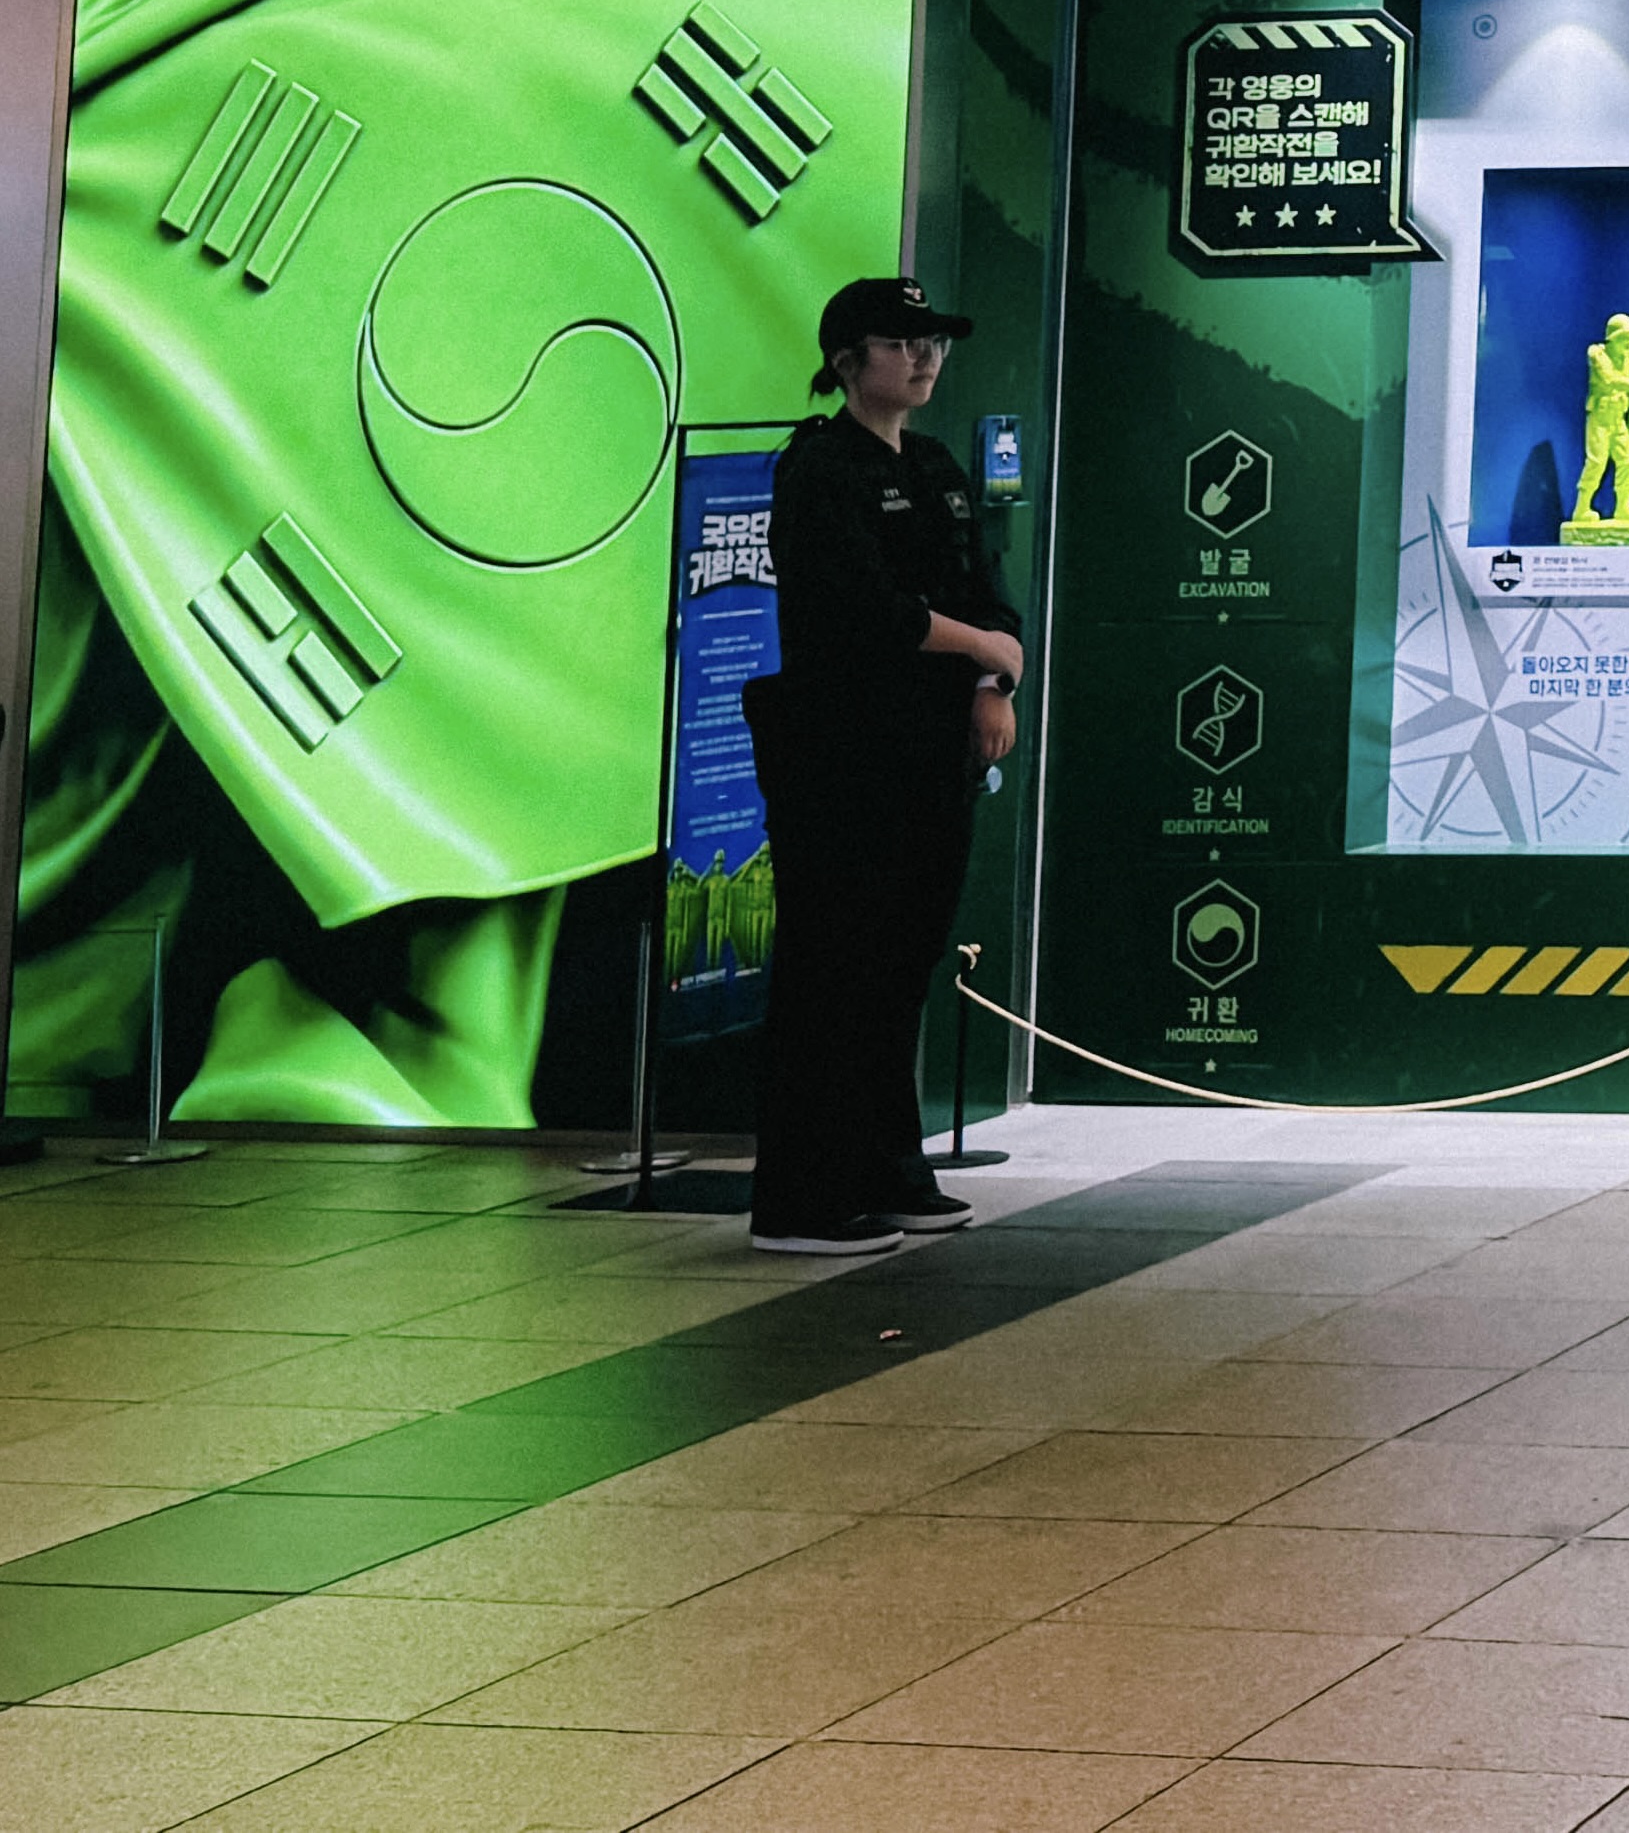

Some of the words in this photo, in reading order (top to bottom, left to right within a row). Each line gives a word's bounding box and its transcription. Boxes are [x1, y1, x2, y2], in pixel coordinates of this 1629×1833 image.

[1208, 77, 1236, 101] 각
[1241, 74, 1322, 101] 영웅의
[1207, 103, 1281, 130] QR을
[1287, 101, 1369, 128] 스캔해
[1205, 131, 1339, 158] 귀환작전을
[1205, 162, 1286, 188] 확인해
[1291, 159, 1381, 186] 보세요!
[702, 510, 772, 548] 국유단
[1179, 581, 1270, 597] EXCAVATION
[1522, 655, 1589, 675] 돌아오지
[1594, 655, 1628, 674] 못한
[1529, 678, 1579, 697] 마지막
[1586, 678, 1601, 697] 한
[1162, 818, 1270, 835] IDENTIFICATION
[1165, 1028, 1259, 1044] HOMECOMING
